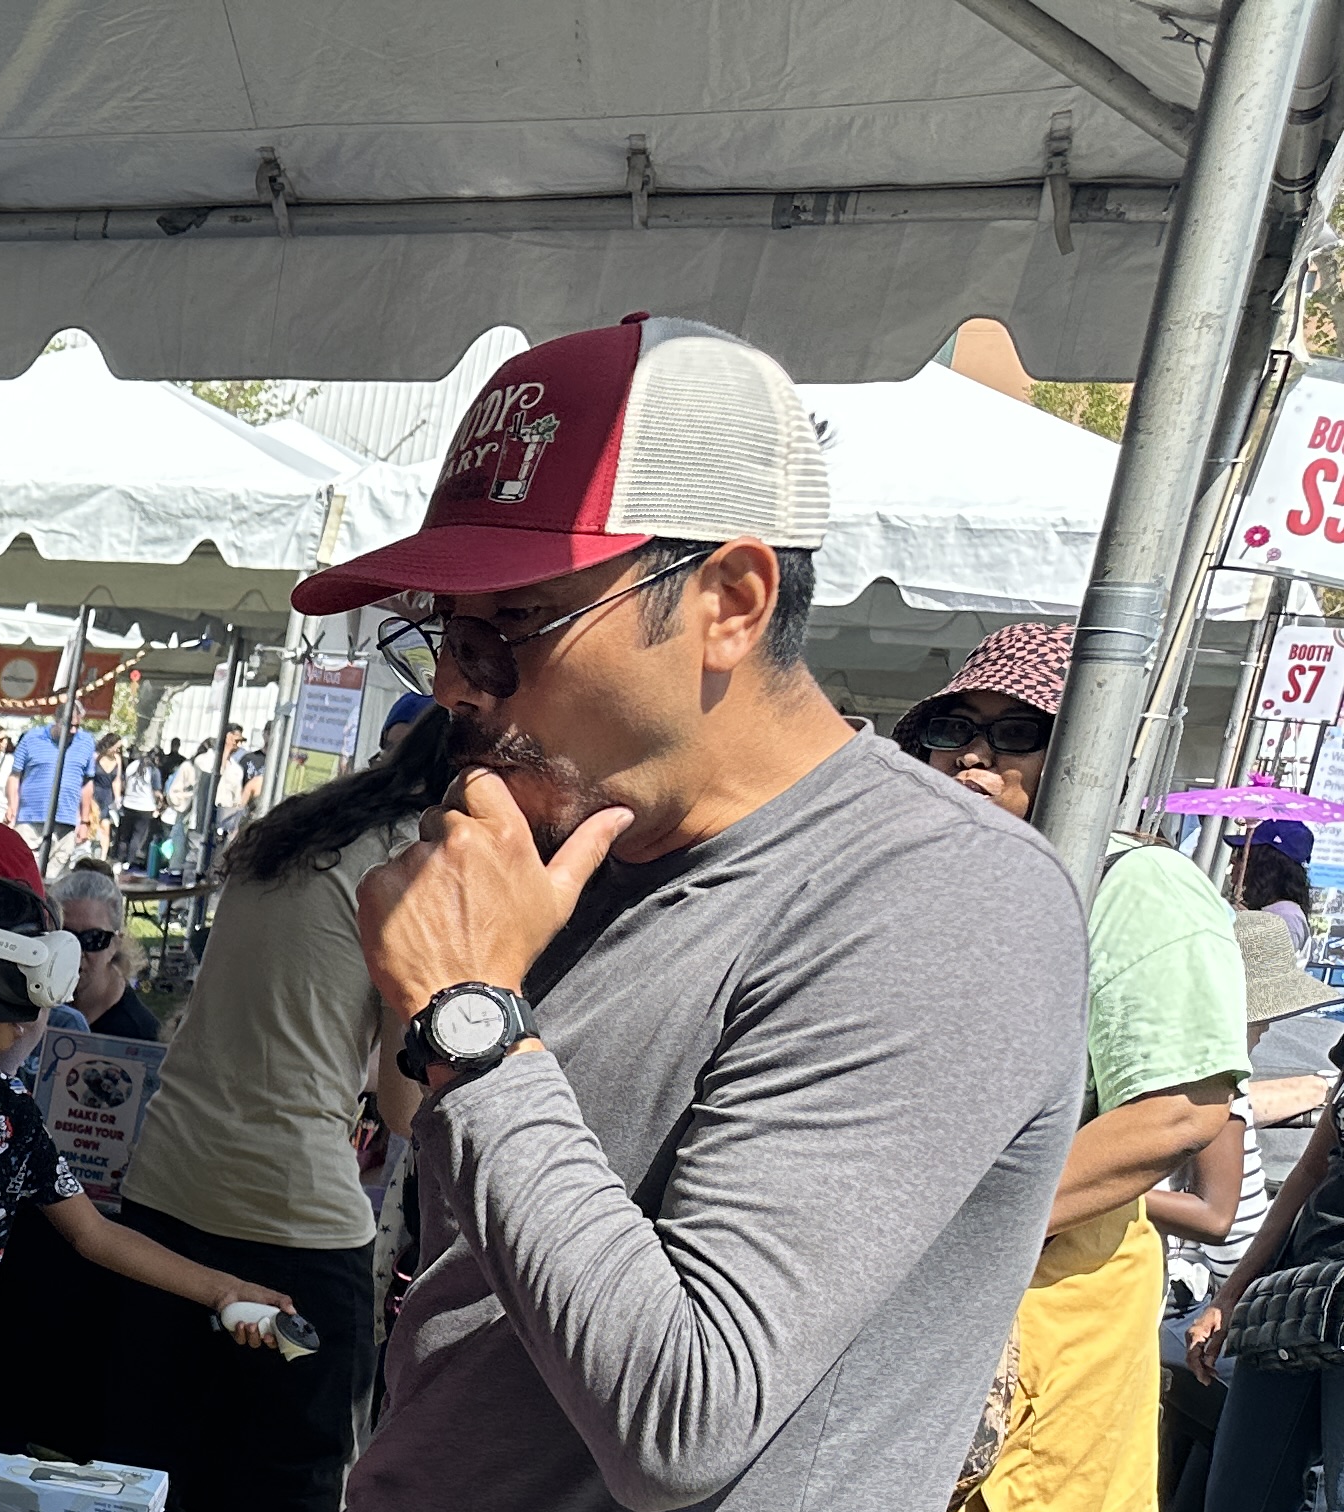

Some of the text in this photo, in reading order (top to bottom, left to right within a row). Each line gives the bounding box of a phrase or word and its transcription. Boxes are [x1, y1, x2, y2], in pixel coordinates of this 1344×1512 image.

[1288, 643, 1334, 663] BOOTH
[1282, 663, 1326, 704] S7
[68, 1107, 117, 1125] MAKE OR
[54, 1120, 125, 1141] DESIGN YOUR
[73, 1137, 100, 1151] OWN
